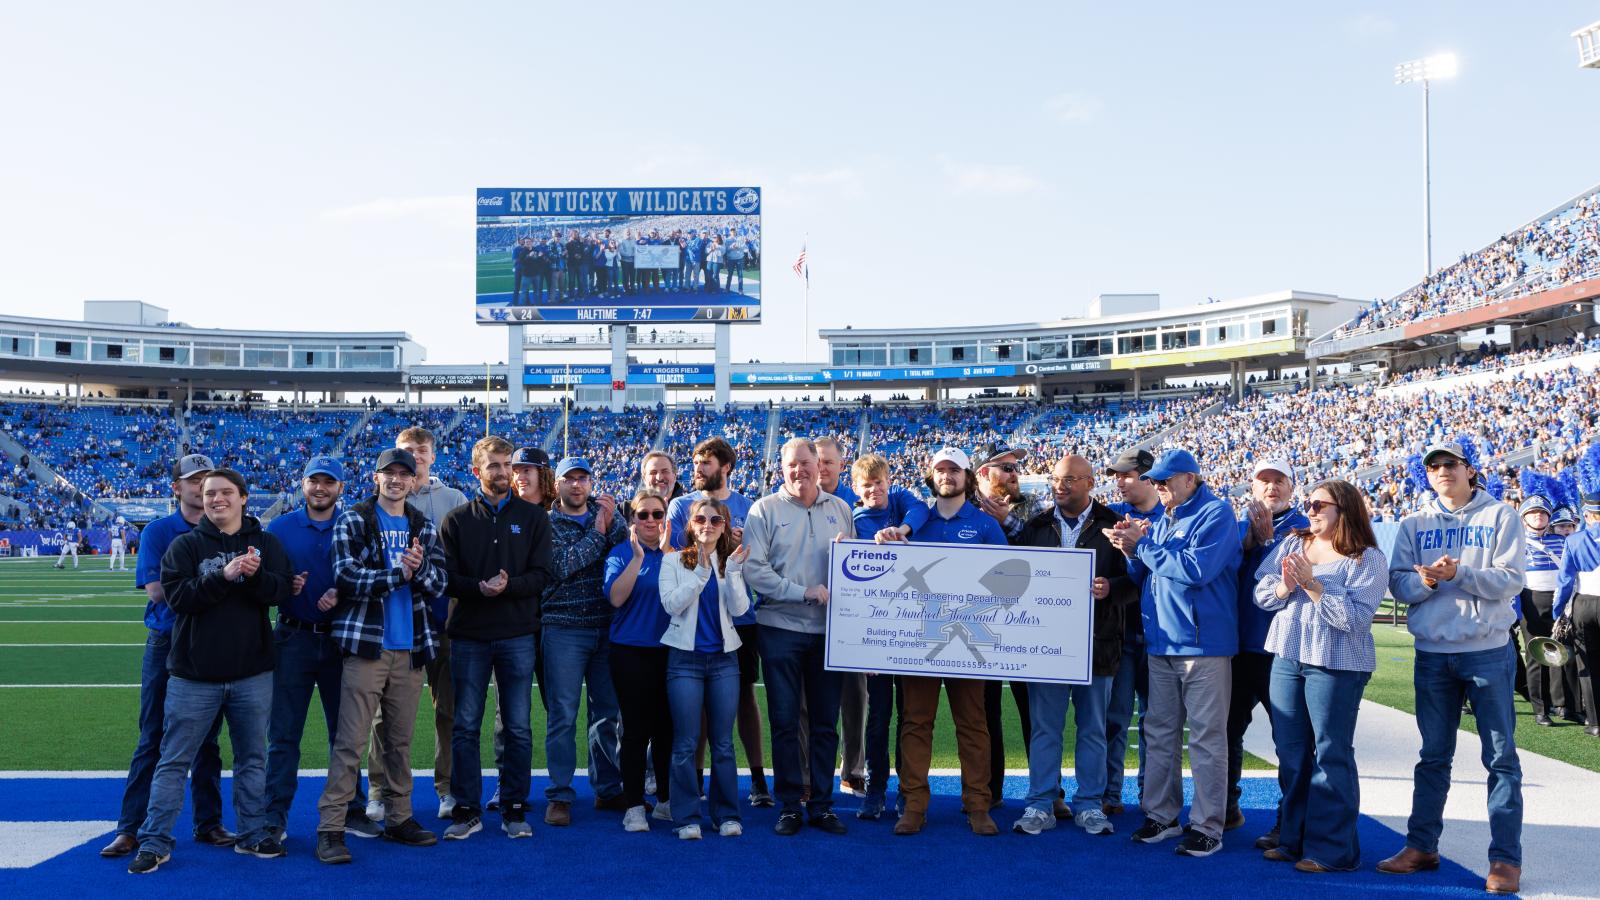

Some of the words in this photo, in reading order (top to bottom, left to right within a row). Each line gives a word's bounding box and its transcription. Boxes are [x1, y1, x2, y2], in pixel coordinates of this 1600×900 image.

[510, 191, 618, 212] KENTUCKY
[629, 190, 727, 212] WILDCATS
[521, 309, 532, 320] 24
[577, 309, 618, 320] HALFTIME
[633, 308, 652, 320] 7:47
[706, 308, 713, 320] 0
[552, 374, 582, 384] KENTUCKY
[656, 374, 685, 384] WILDCATS
[613, 381, 625, 390] 25
[1416, 526, 1495, 550] KENTUCKY
[851, 549, 898, 561] Friends
[863, 564, 885, 572] Coal
[1035, 569, 1051, 577] 2024
[864, 588, 878, 598] UK
[880, 589, 909, 600] Mining
[911, 590, 964, 603] Engineering
[966, 593, 1019, 604] Department
[868, 605, 889, 618] Two
[896, 606, 941, 619] Hundred
[947, 608, 998, 623] Thousand
[1004, 610, 1040, 625] Dollars
[866, 628, 897, 638] Building
[899, 630, 923, 638] Future
[862, 637, 887, 647] Mining
[889, 639, 927, 648] Engineers
[994, 643, 1027, 653] Friends
[1029, 645, 1038, 653] of
[1041, 646, 1062, 655] Coal
